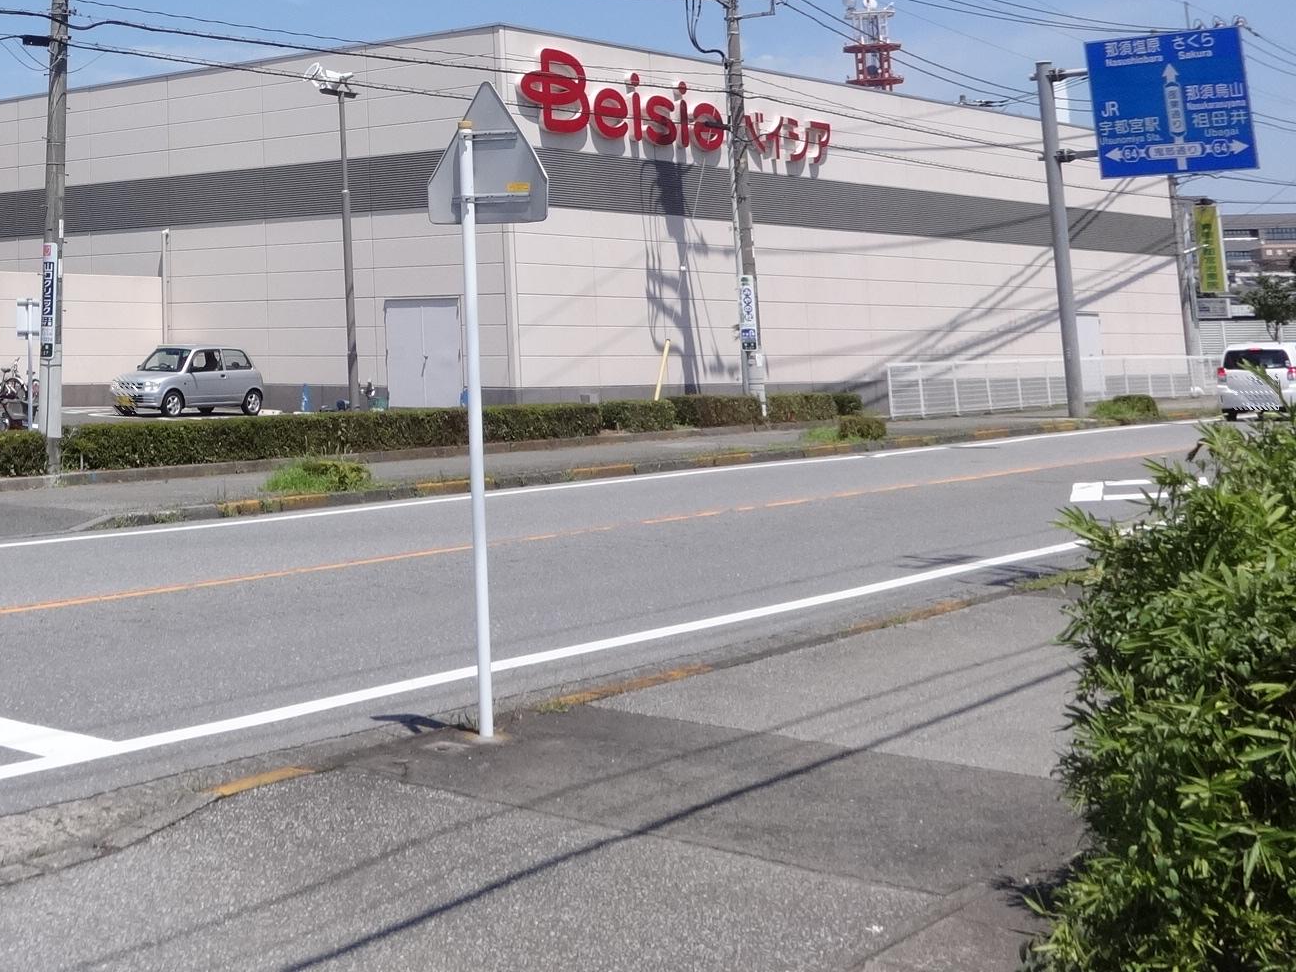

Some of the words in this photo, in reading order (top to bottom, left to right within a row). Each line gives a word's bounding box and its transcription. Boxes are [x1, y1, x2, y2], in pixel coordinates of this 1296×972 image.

[1105, 37, 1162, 58] 那須塩原
[1172, 32, 1214, 50] さくら
[1178, 49, 1213, 60] Sakura
[520, 48, 725, 152] Beisia
[1101, 101, 1120, 117] JR
[1099, 116, 1161, 136] 宇都宮駅
[1191, 109, 1249, 127] 祖母井
[740, 112, 830, 164] ベイシア
[1124, 148, 1138, 159] 64
[1214, 143, 1227, 153] 64
